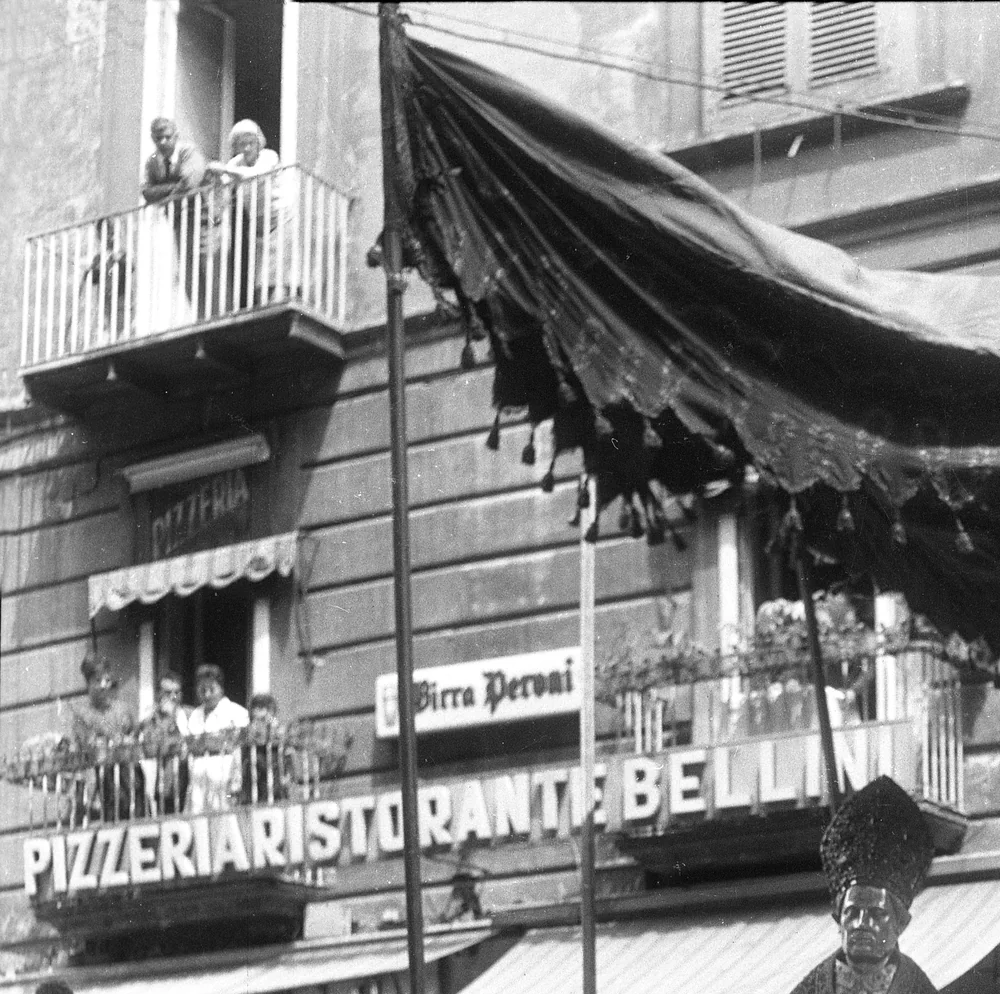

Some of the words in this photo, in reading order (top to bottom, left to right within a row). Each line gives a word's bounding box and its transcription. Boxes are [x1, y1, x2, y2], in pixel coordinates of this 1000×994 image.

[412, 679, 475, 714] Birra
[482, 657, 573, 716] Peroni
[23, 813, 250, 896] PIZZERIA
[252, 762, 608, 870] RISTORANTE
[622, 726, 894, 822] BELLINI
